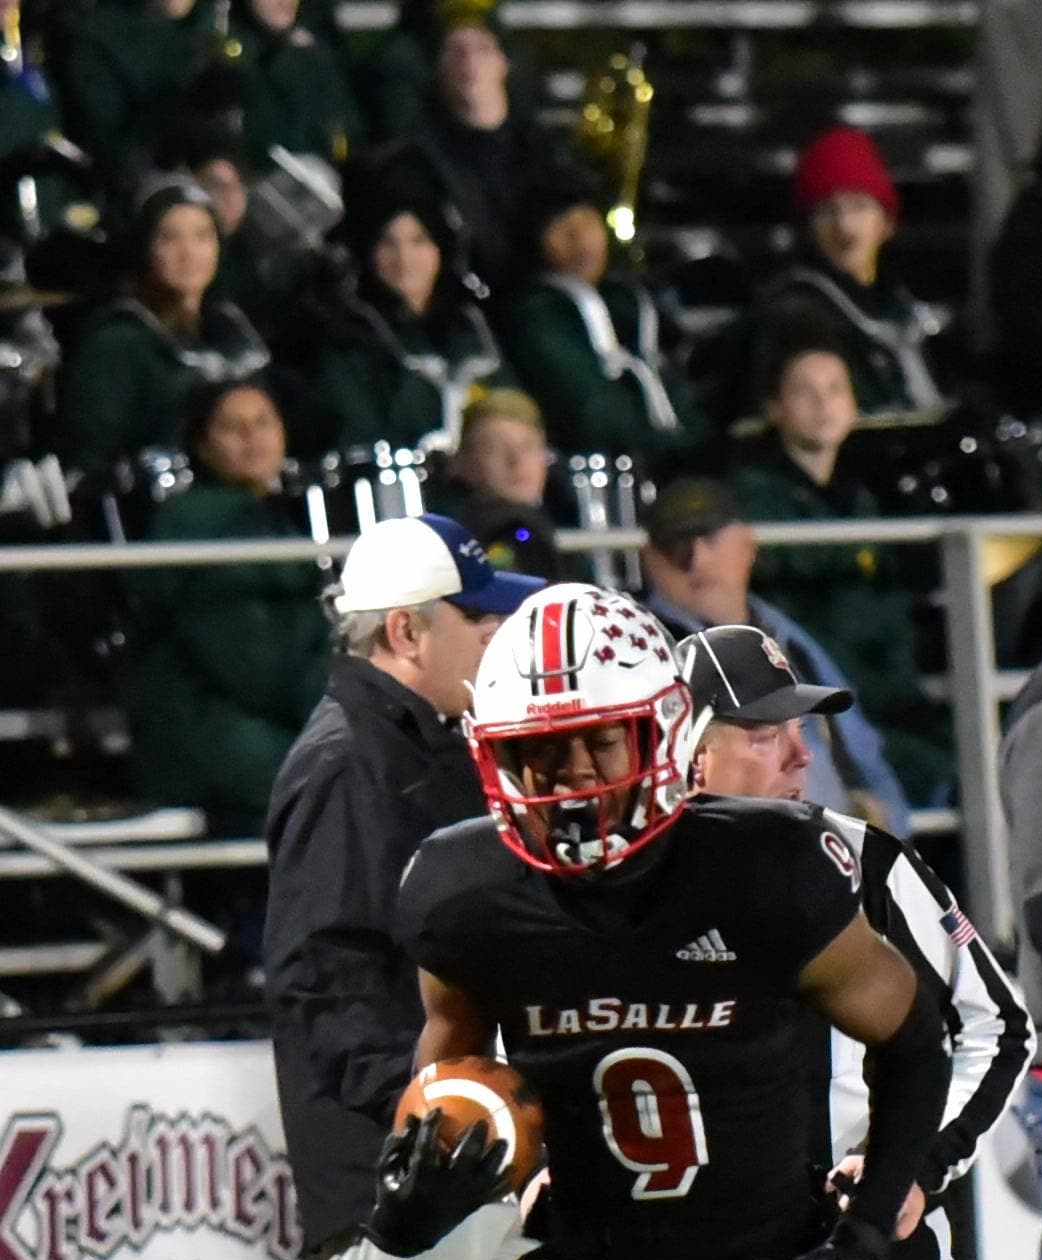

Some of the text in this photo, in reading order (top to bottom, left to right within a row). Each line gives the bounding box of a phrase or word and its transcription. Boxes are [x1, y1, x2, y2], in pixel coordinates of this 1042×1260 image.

[527, 698, 581, 715] Riddell
[821, 832, 861, 894] 9
[676, 949, 738, 962] adidas
[592, 1046, 710, 1201] 9
